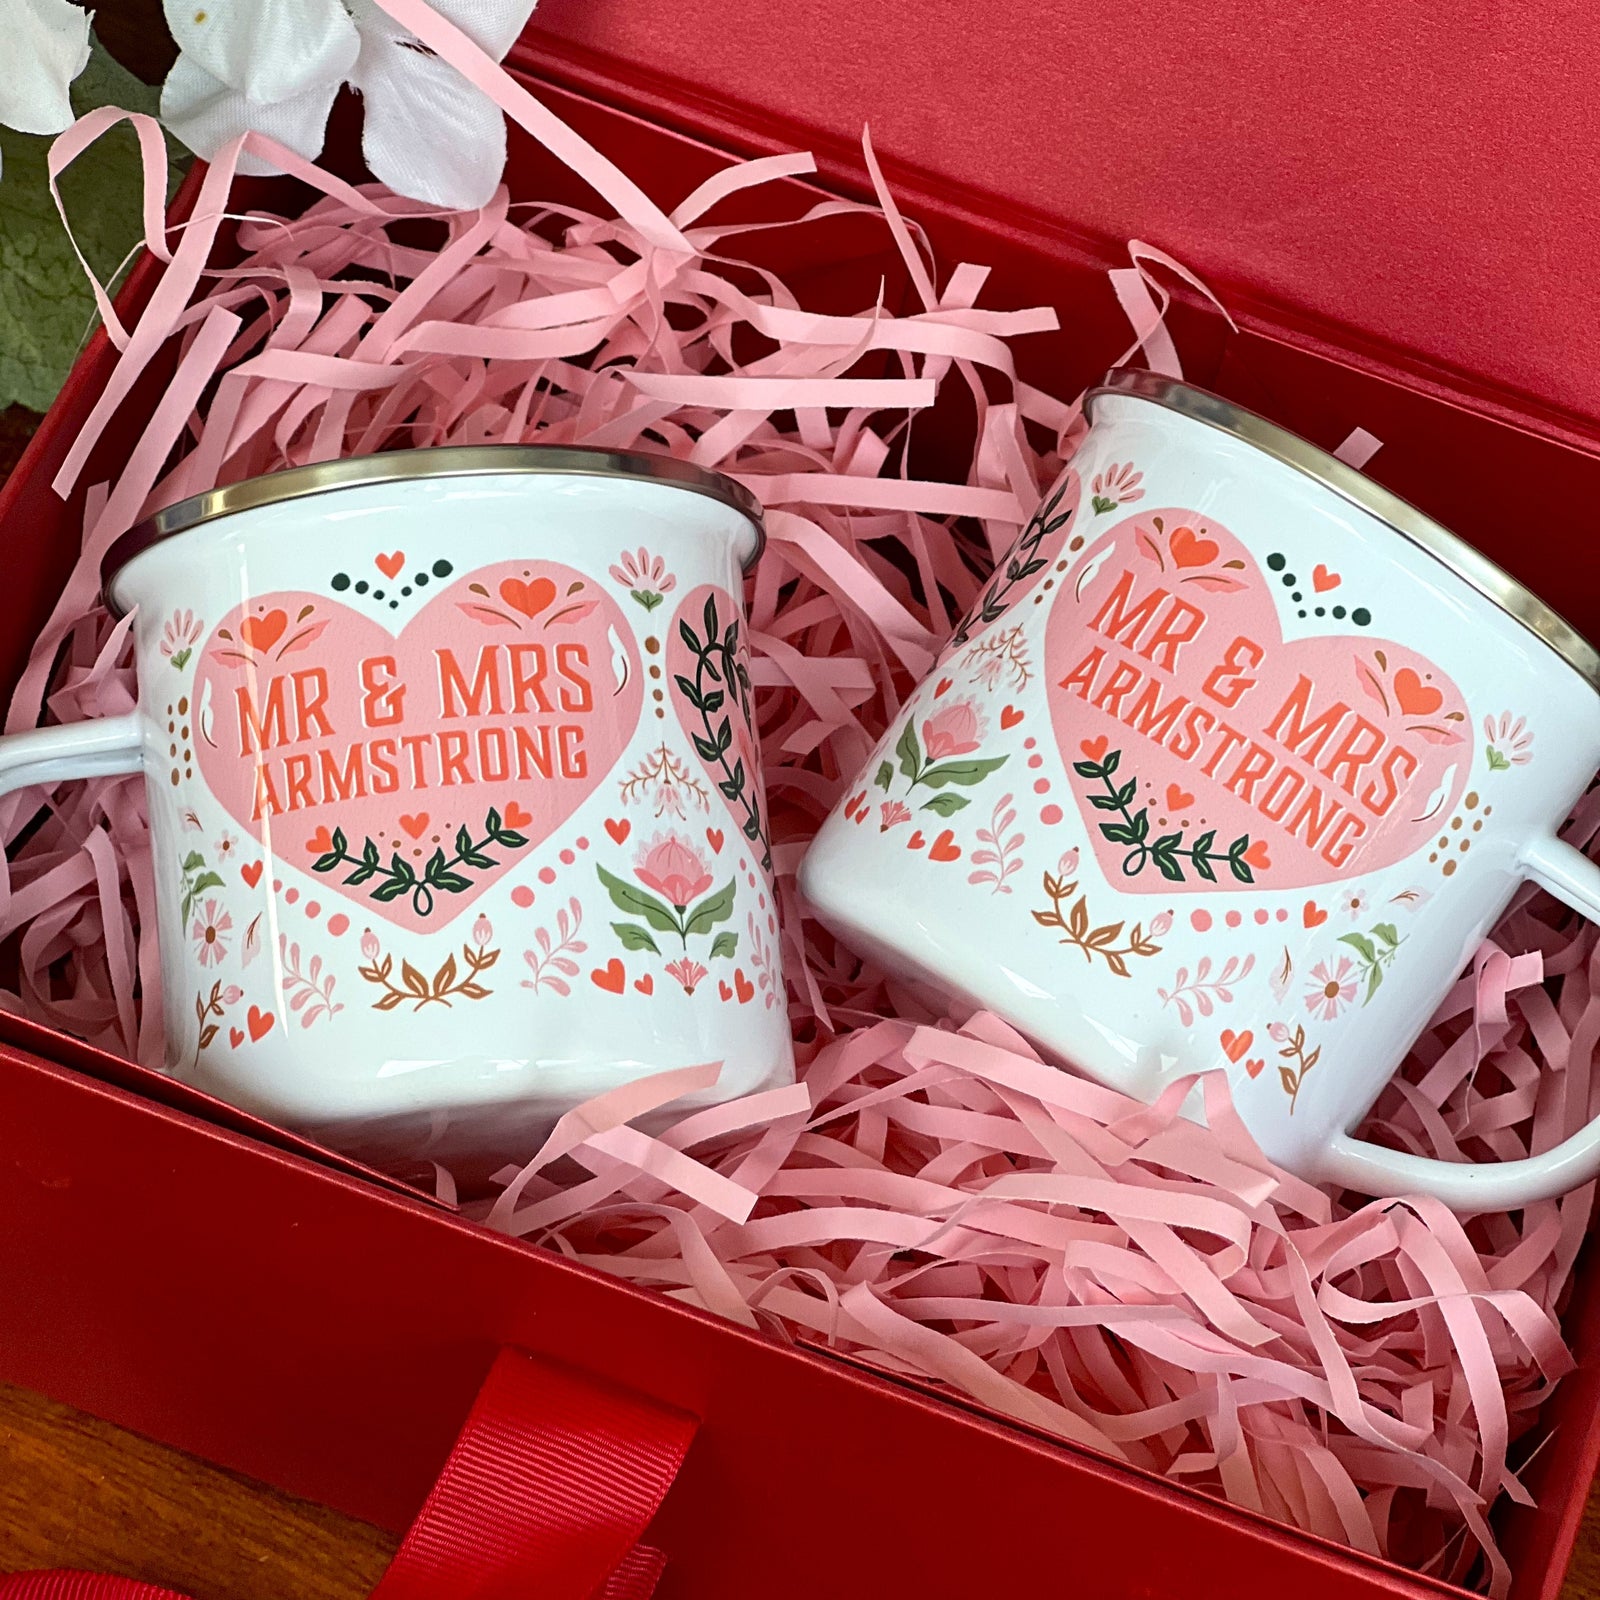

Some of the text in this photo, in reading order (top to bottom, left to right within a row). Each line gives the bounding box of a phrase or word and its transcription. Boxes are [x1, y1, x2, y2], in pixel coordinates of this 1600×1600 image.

[234, 643, 593, 758] MR & MRS
[250, 725, 588, 822] ARMSTRONG
[1057, 645, 1370, 870] ARMSTRONG
[1086, 569, 1423, 818] MR & MRS
